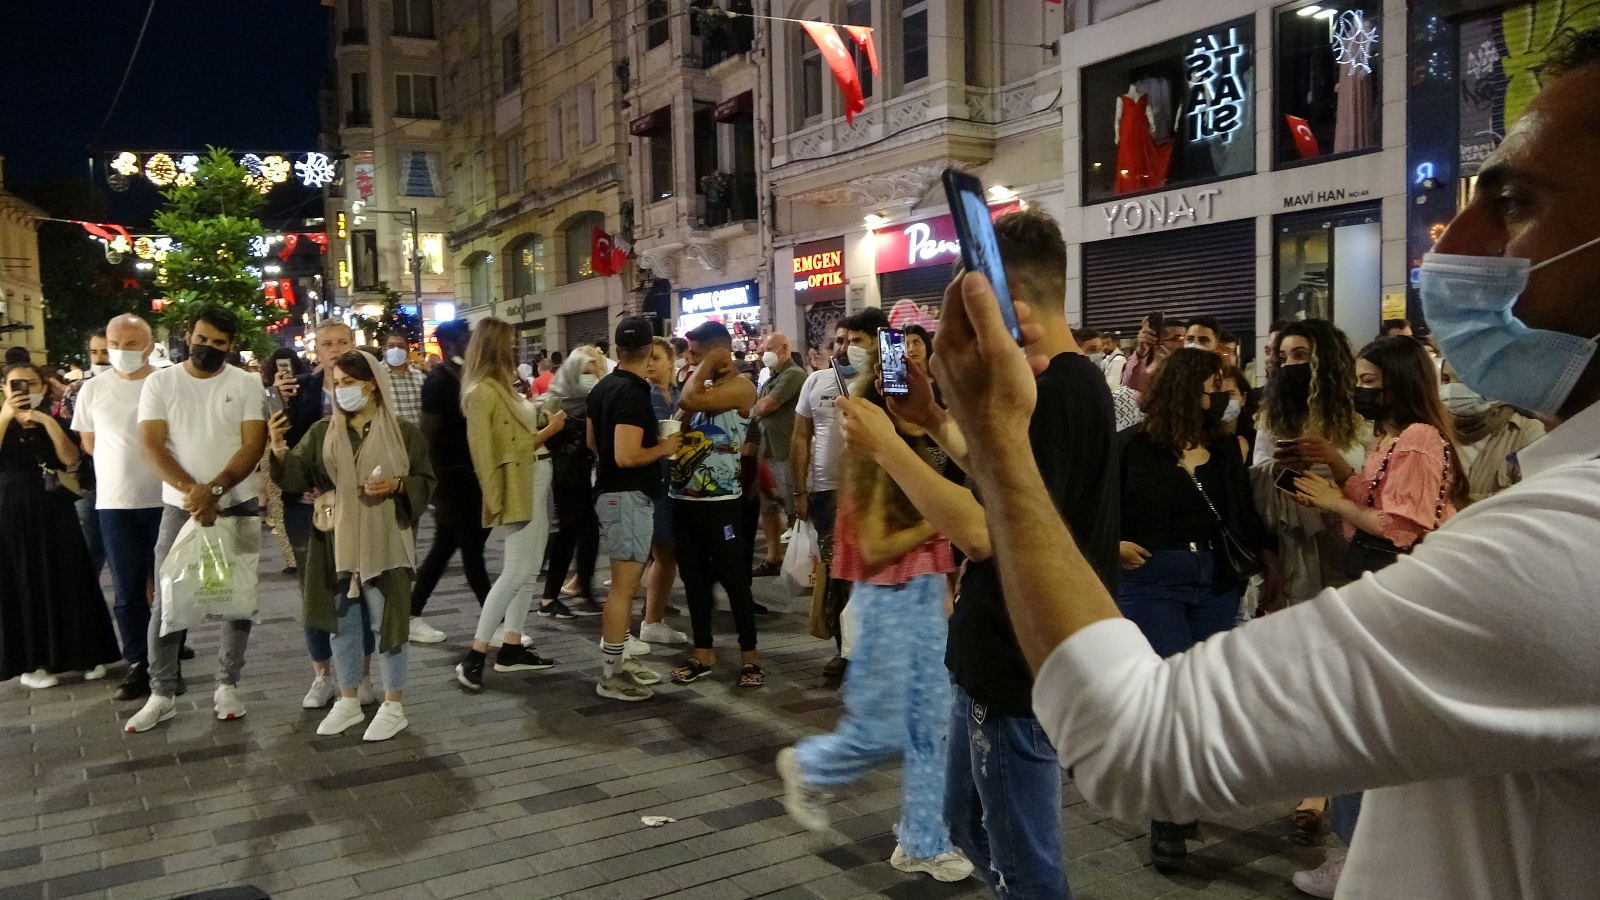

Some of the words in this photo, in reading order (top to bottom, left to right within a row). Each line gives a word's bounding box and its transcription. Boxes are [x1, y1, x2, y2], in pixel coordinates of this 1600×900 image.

[1283, 191, 1314, 208] MAVİ
[1317, 188, 1345, 203] HAN
[1102, 188, 1221, 235] YONAT
[792, 250, 842, 273] EMGEN
